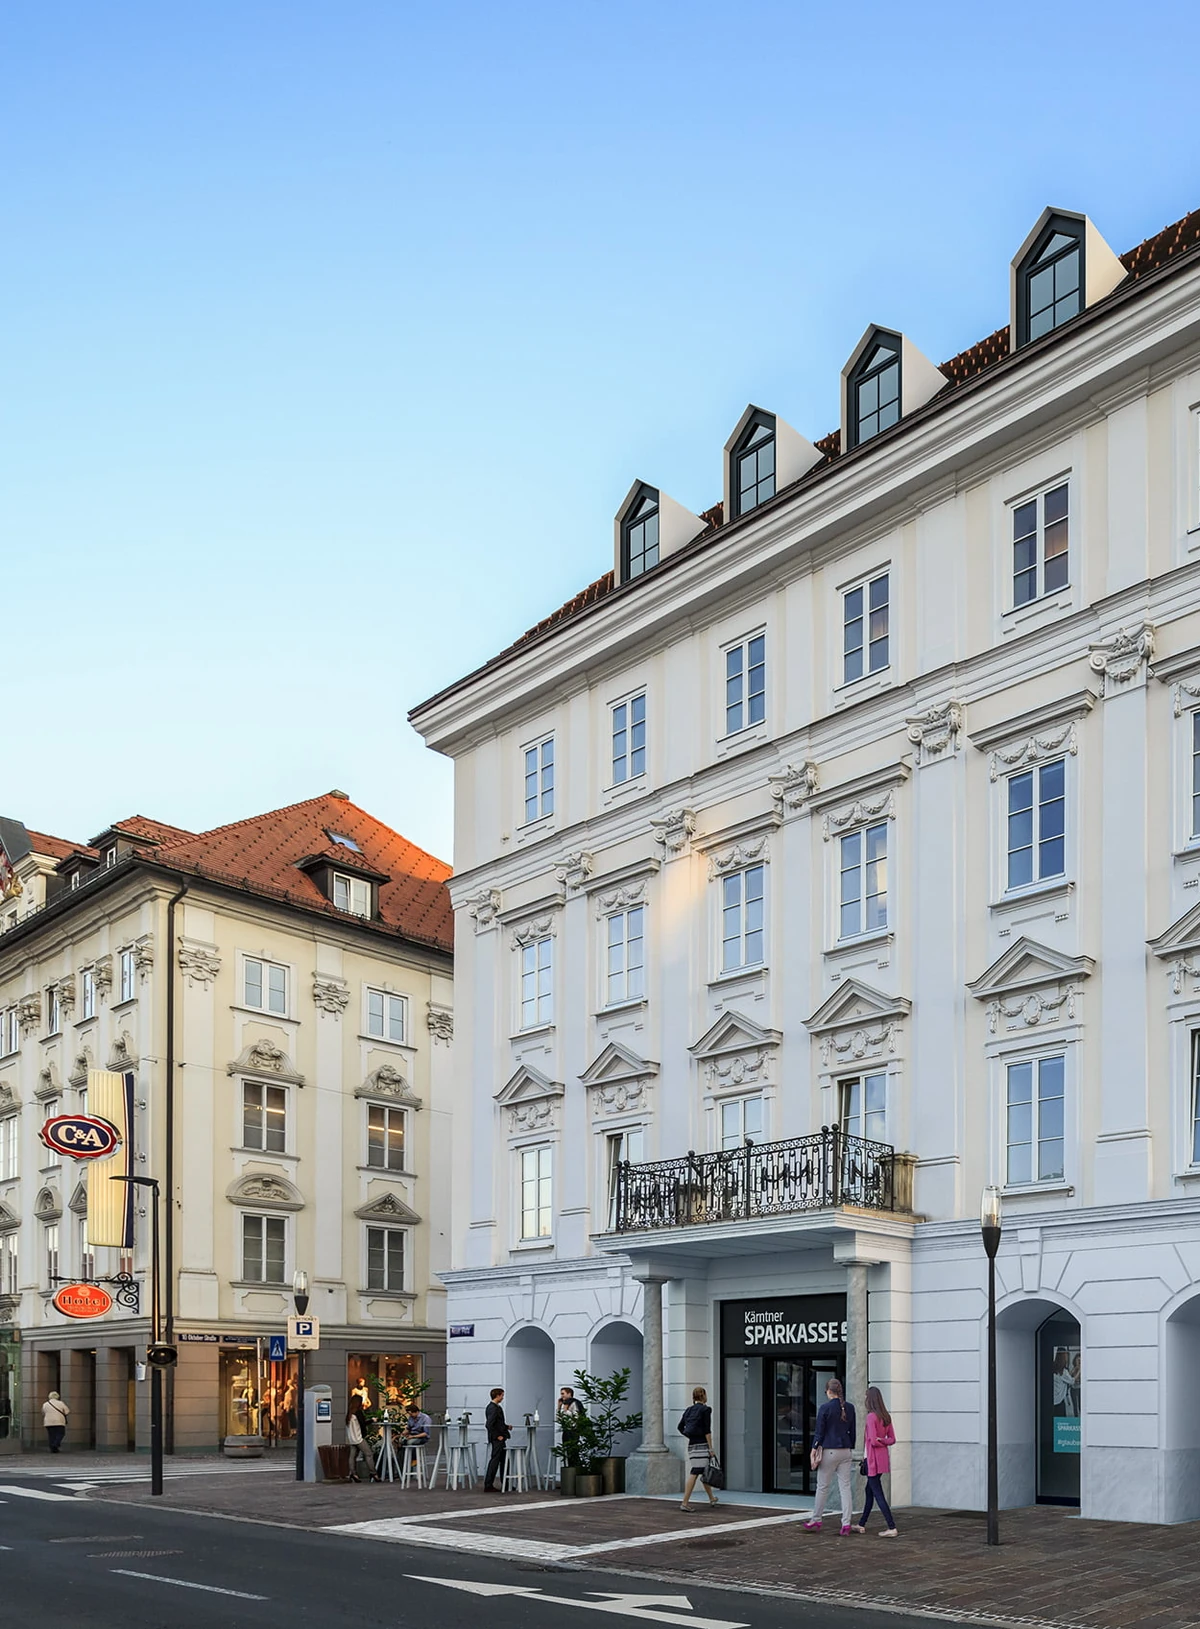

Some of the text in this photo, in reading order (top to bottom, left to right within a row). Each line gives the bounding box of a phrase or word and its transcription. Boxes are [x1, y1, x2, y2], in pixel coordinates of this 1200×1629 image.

[57, 1124, 104, 1147] C&A
[62, 1295, 107, 1306] Hotel
[744, 1310, 784, 1323] Kärntner
[299, 1323, 310, 1334] P
[745, 1322, 838, 1345] SPARKASSE
